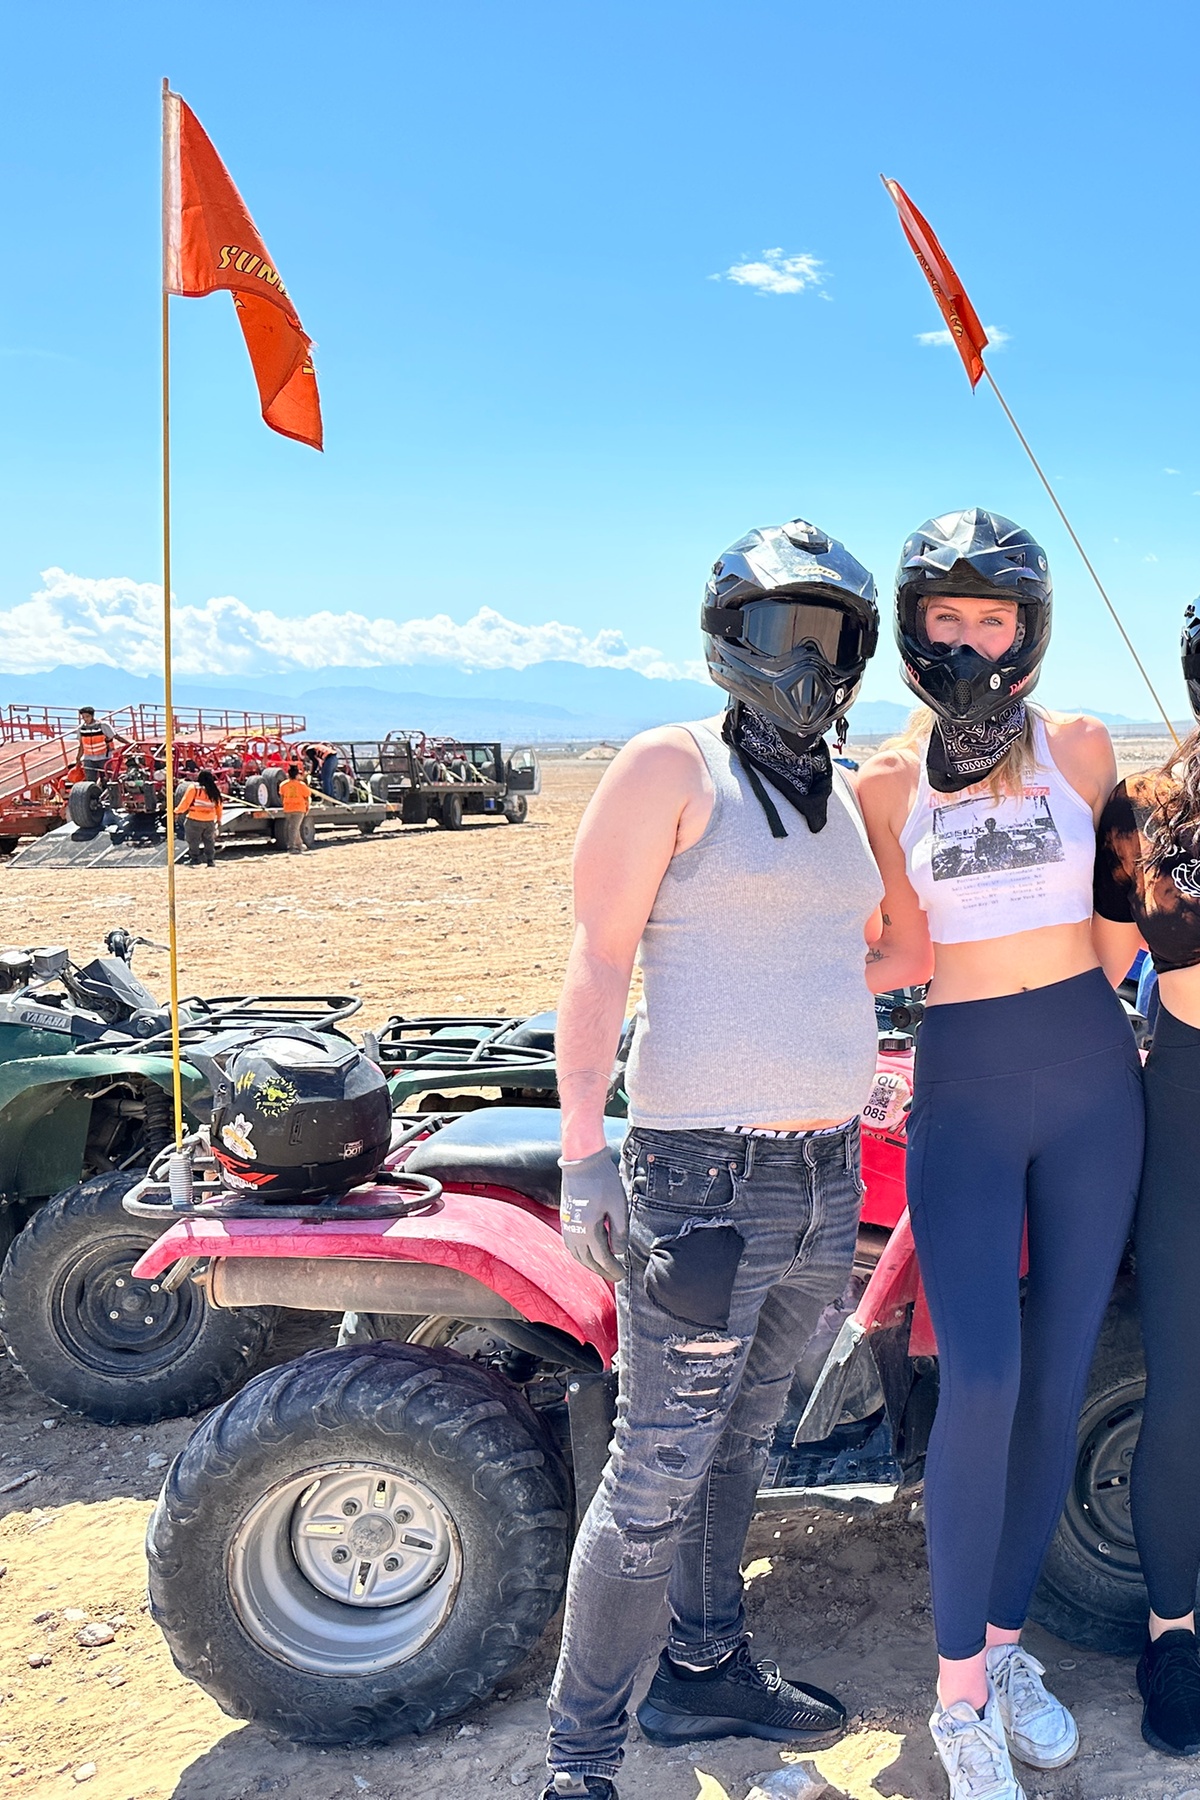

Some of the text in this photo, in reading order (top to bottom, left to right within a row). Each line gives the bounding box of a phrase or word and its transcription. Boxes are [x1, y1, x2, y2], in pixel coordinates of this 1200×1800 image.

[25, 1012, 68, 1028] YAMAHA
[877, 1075, 899, 1090] QU
[862, 1105, 887, 1122] 085
